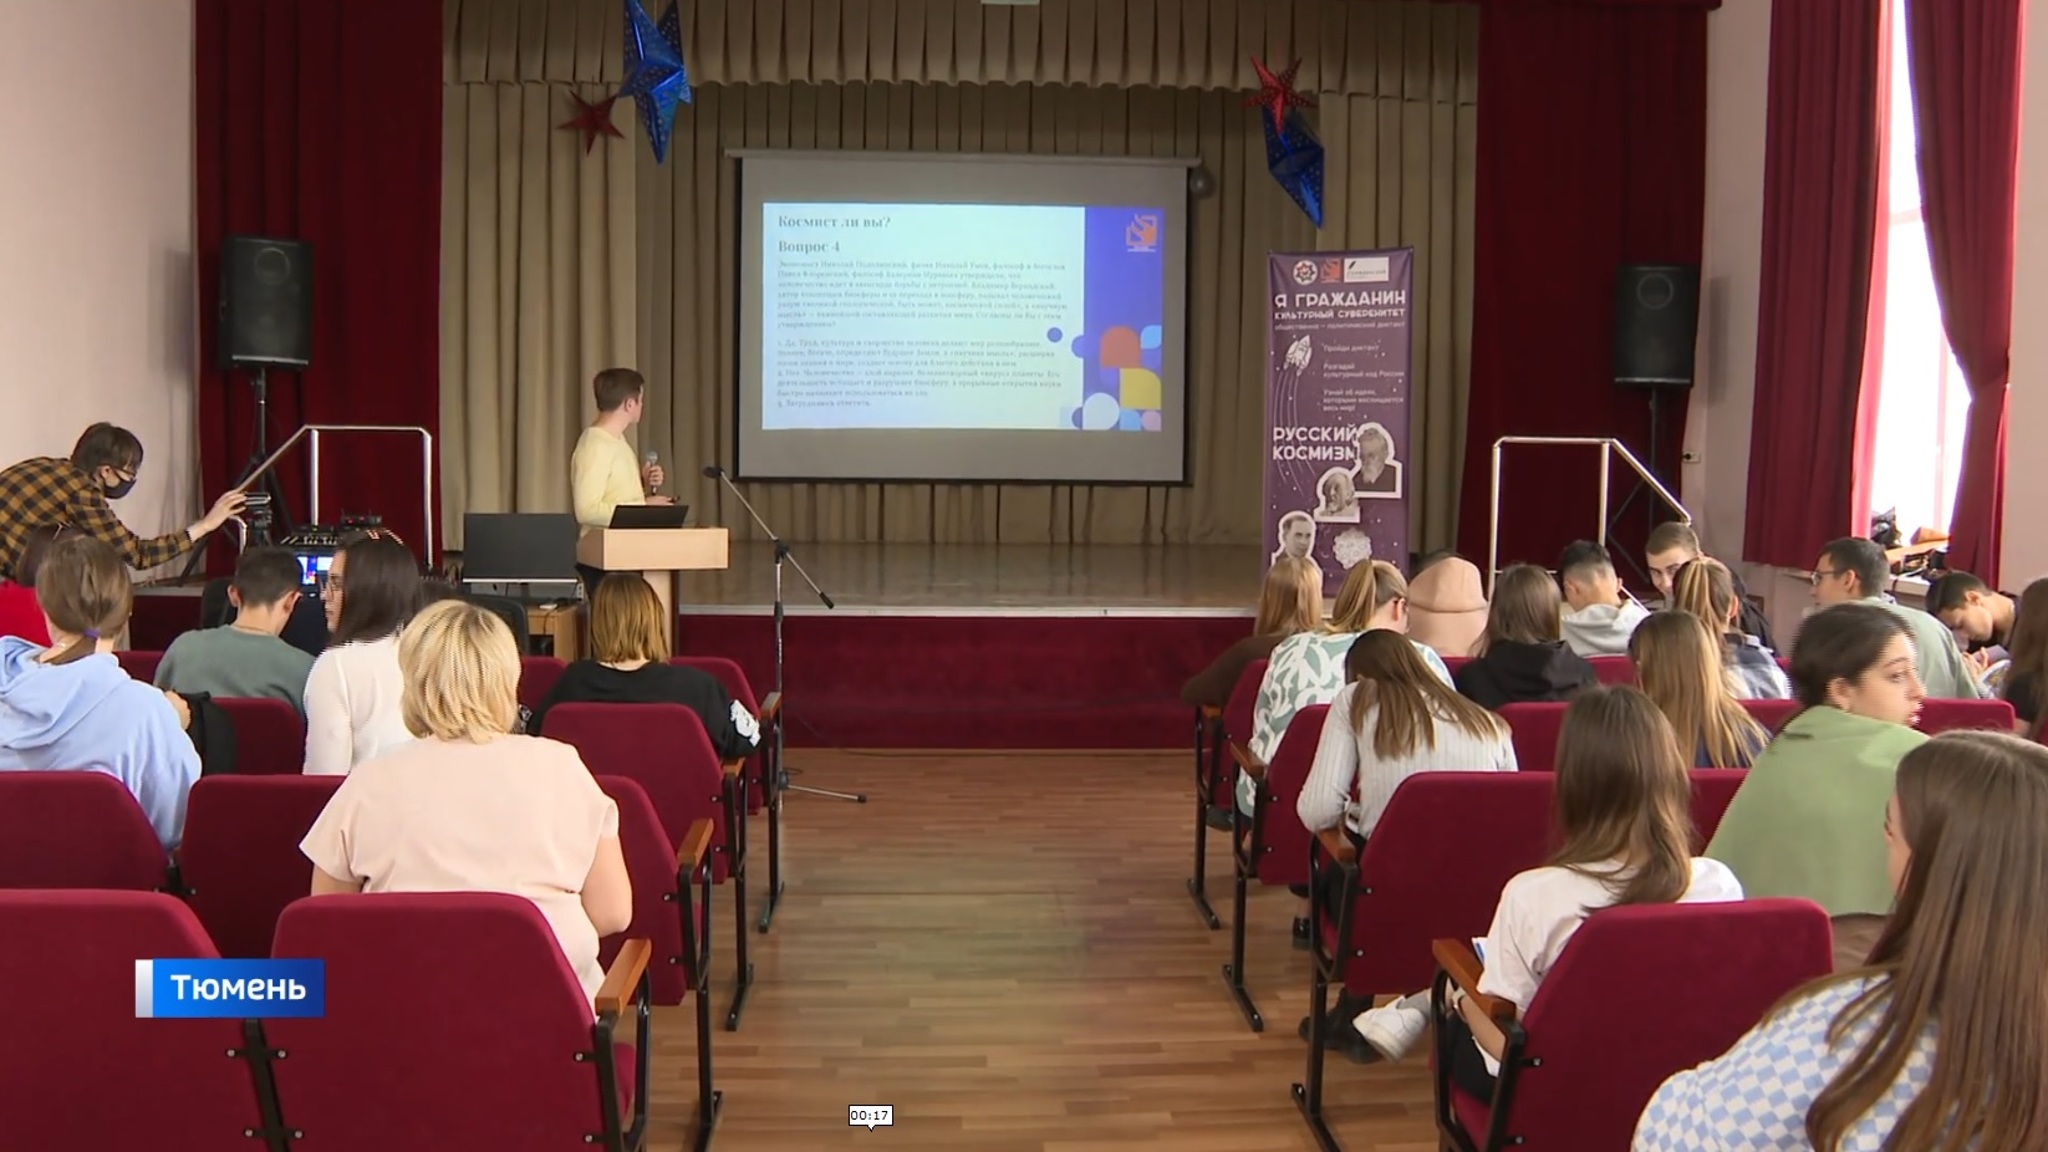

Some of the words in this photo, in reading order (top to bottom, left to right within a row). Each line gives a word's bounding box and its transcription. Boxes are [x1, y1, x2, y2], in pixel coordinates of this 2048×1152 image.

[779, 216, 838, 228] Космист
[841, 218, 860, 228] ли
[864, 216, 891, 228] вы?
[779, 241, 829, 254] Вопрос
[831, 241, 840, 252] 4
[1274, 293, 1287, 308] Я
[1295, 290, 1406, 307] ГРАЖДАНИН
[1274, 309, 1334, 320] КУЛЬТУРНЫЙ
[1338, 308, 1405, 318] СУВЕРЕНИТЕТ
[1273, 423, 1357, 442] РУССКИЙ
